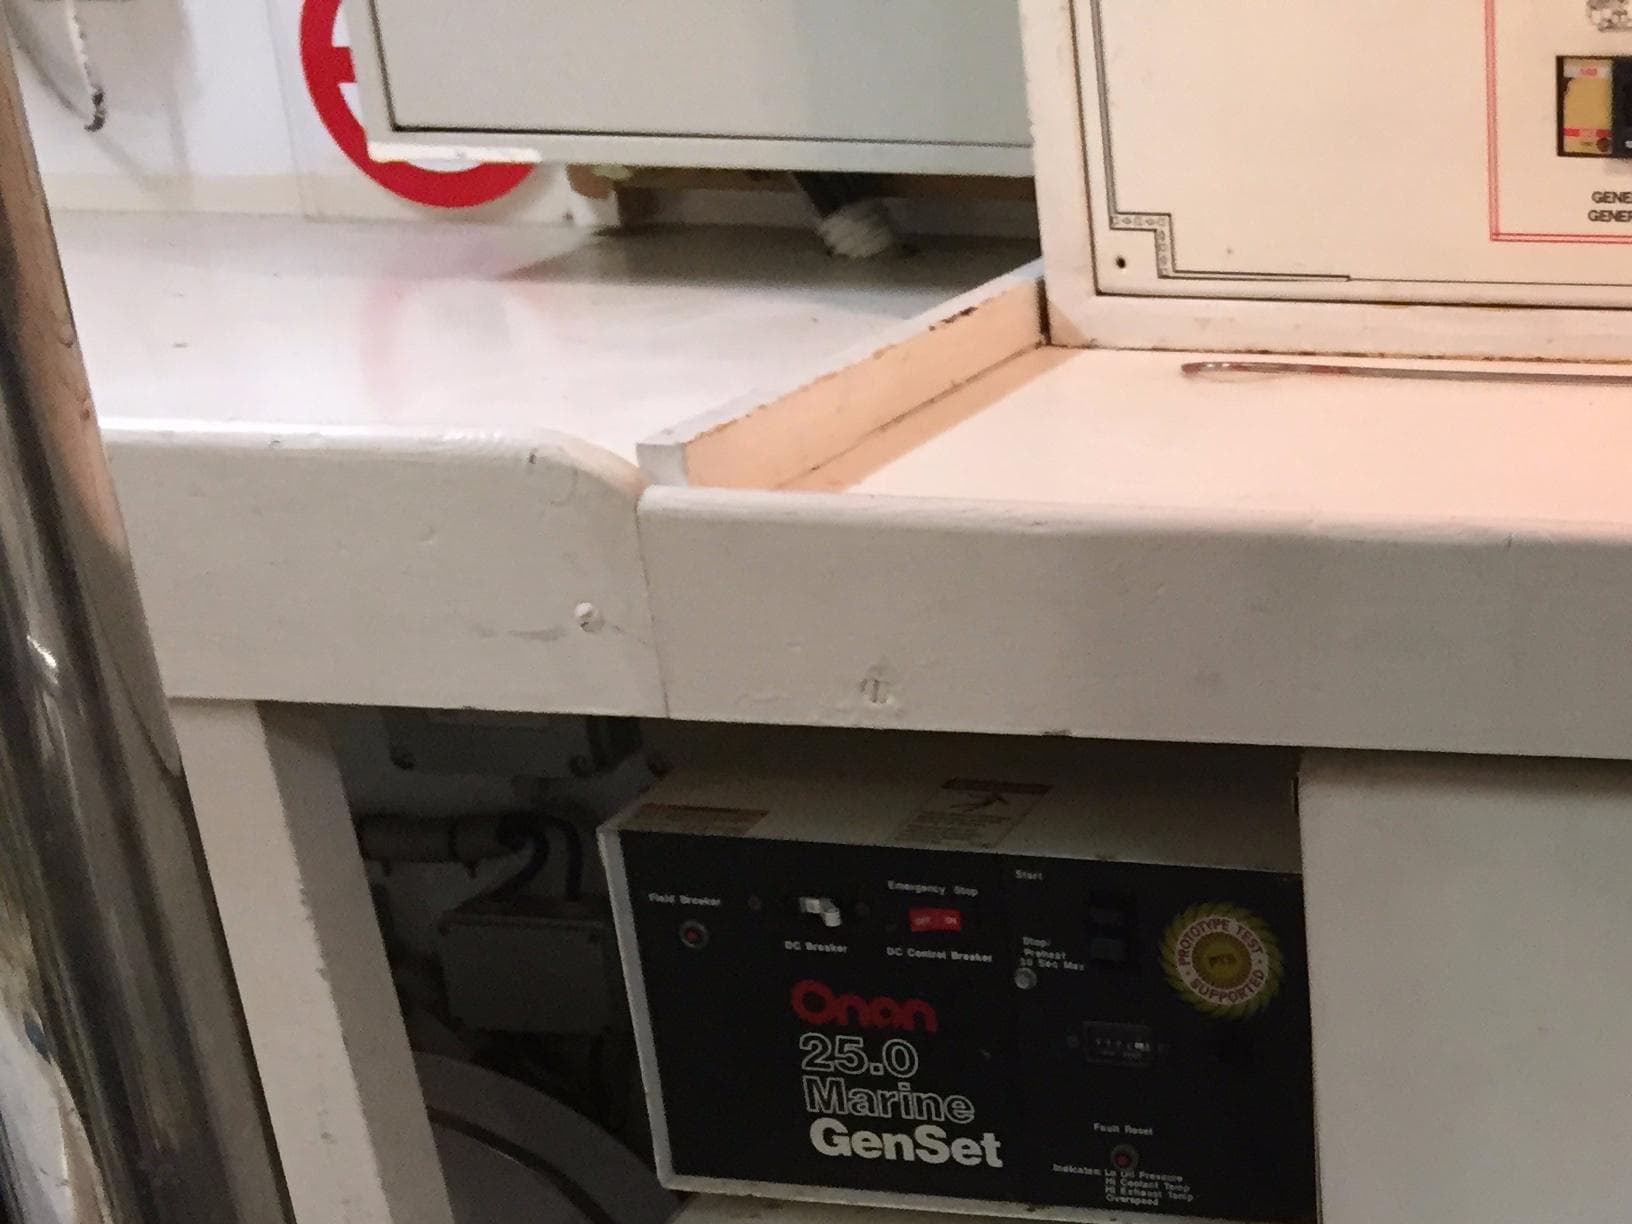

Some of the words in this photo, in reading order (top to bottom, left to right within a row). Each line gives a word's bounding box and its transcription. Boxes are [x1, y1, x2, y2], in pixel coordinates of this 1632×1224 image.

[1015, 869, 1043, 880] Start
[887, 879, 946, 896] Emergency
[952, 885, 979, 897] Stop
[679, 894, 721, 907] Breaker
[784, 940, 801, 951] DC
[804, 941, 848, 953] Breaker
[1178, 918, 1231, 966] PROTOTYPE
[1236, 926, 1263, 954] TEST
[886, 946, 903, 956] DC
[906, 947, 947, 960] Control
[951, 951, 993, 962] Breaker
[1191, 969, 1265, 1002] SUPPORTED
[790, 979, 939, 1035] Onan
[799, 1032, 919, 1079] 25.0
[802, 1075, 976, 1124] Marine
[1093, 1122, 1120, 1133] Fault
[1124, 1124, 1153, 1136] Reset
[809, 1117, 1004, 1168] GenSet
[1139, 1170, 1183, 1183] Pressure
[1119, 1178, 1159, 1189] Coolant
[1163, 1181, 1191, 1193] Temp
[1105, 1193, 1160, 1207] Overspeed
[1120, 1186, 1162, 1198] Exhaust
[1169, 1191, 1194, 1203] Temp
